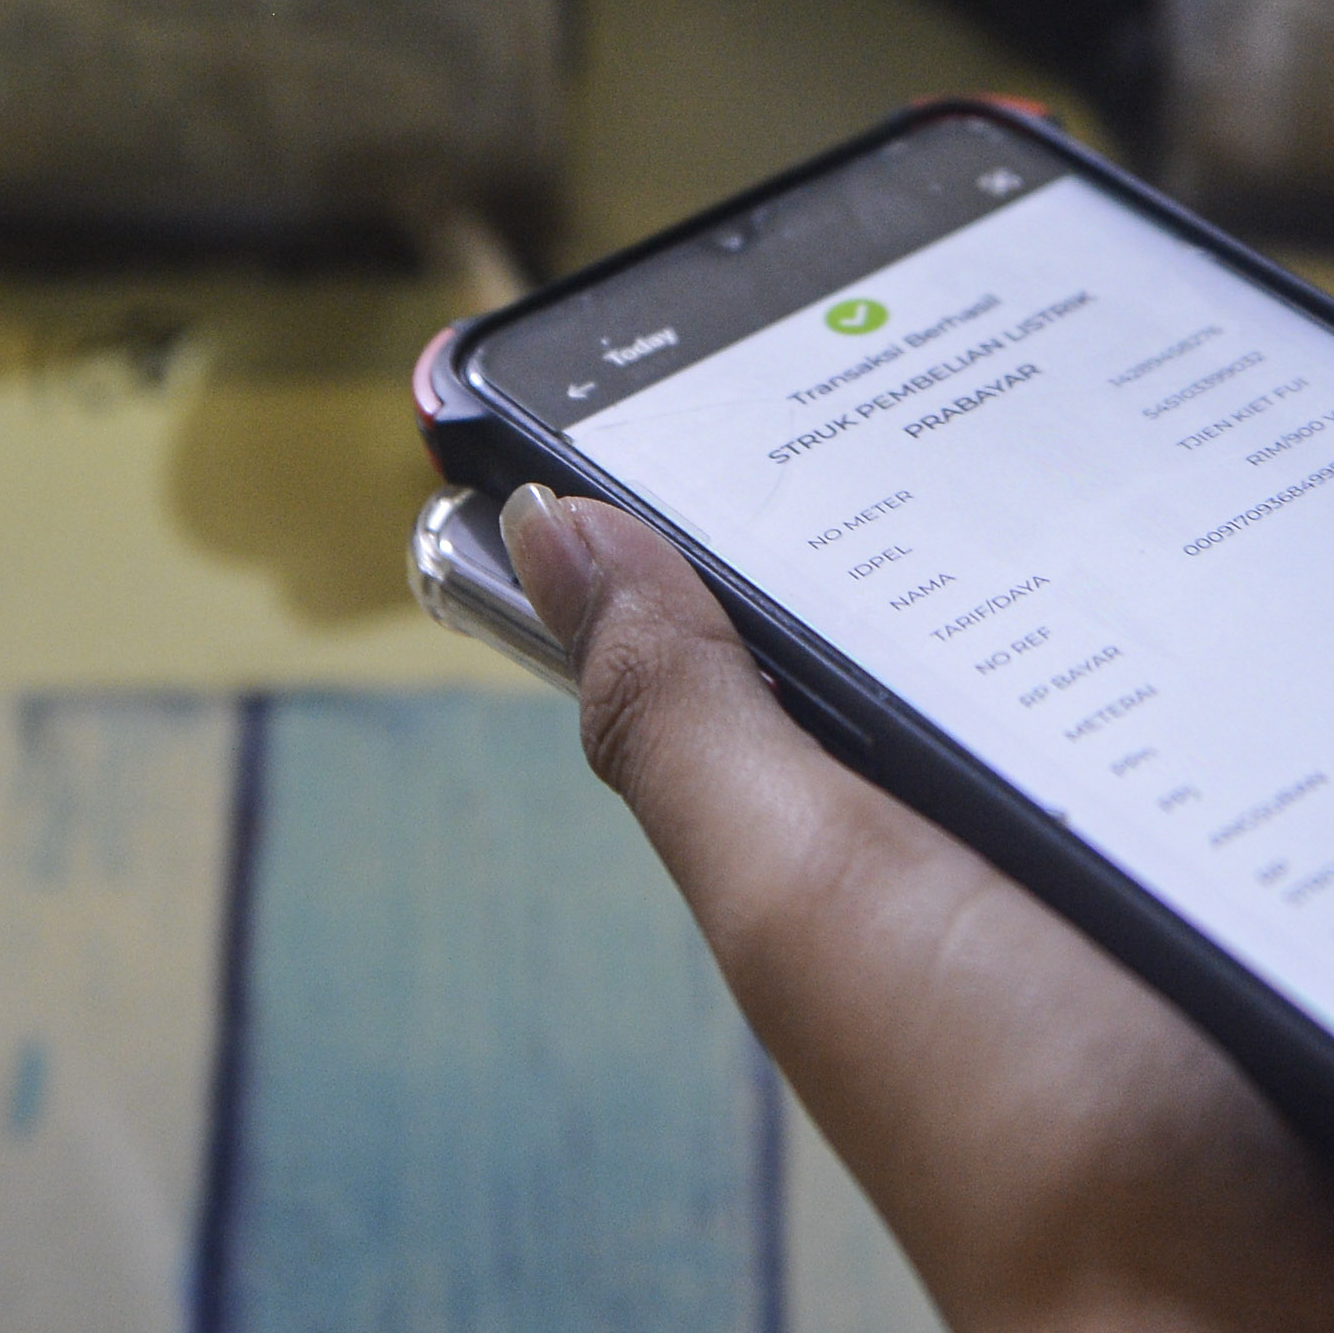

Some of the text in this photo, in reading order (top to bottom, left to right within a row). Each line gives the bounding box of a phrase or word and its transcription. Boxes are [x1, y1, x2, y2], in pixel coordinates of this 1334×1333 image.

[602, 326, 679, 367] Today
[765, 289, 1095, 466] STRUK PEMBELIAN LISTRIK
[784, 291, 1003, 407] Transaksi Berhasil
[900, 361, 1043, 440] PRABAYAR
[1173, 375, 1311, 452] TJIEN KIET FUI
[805, 488, 916, 551] NO METER
[845, 543, 914, 582] IDPEL
[887, 571, 958, 612] NAMA
[927, 573, 1052, 643] TARIF/DAYA
[972, 624, 1052, 676] NO REF
[1018, 644, 1123, 708] RP BAYAR
[1062, 683, 1159, 742] METERAI
